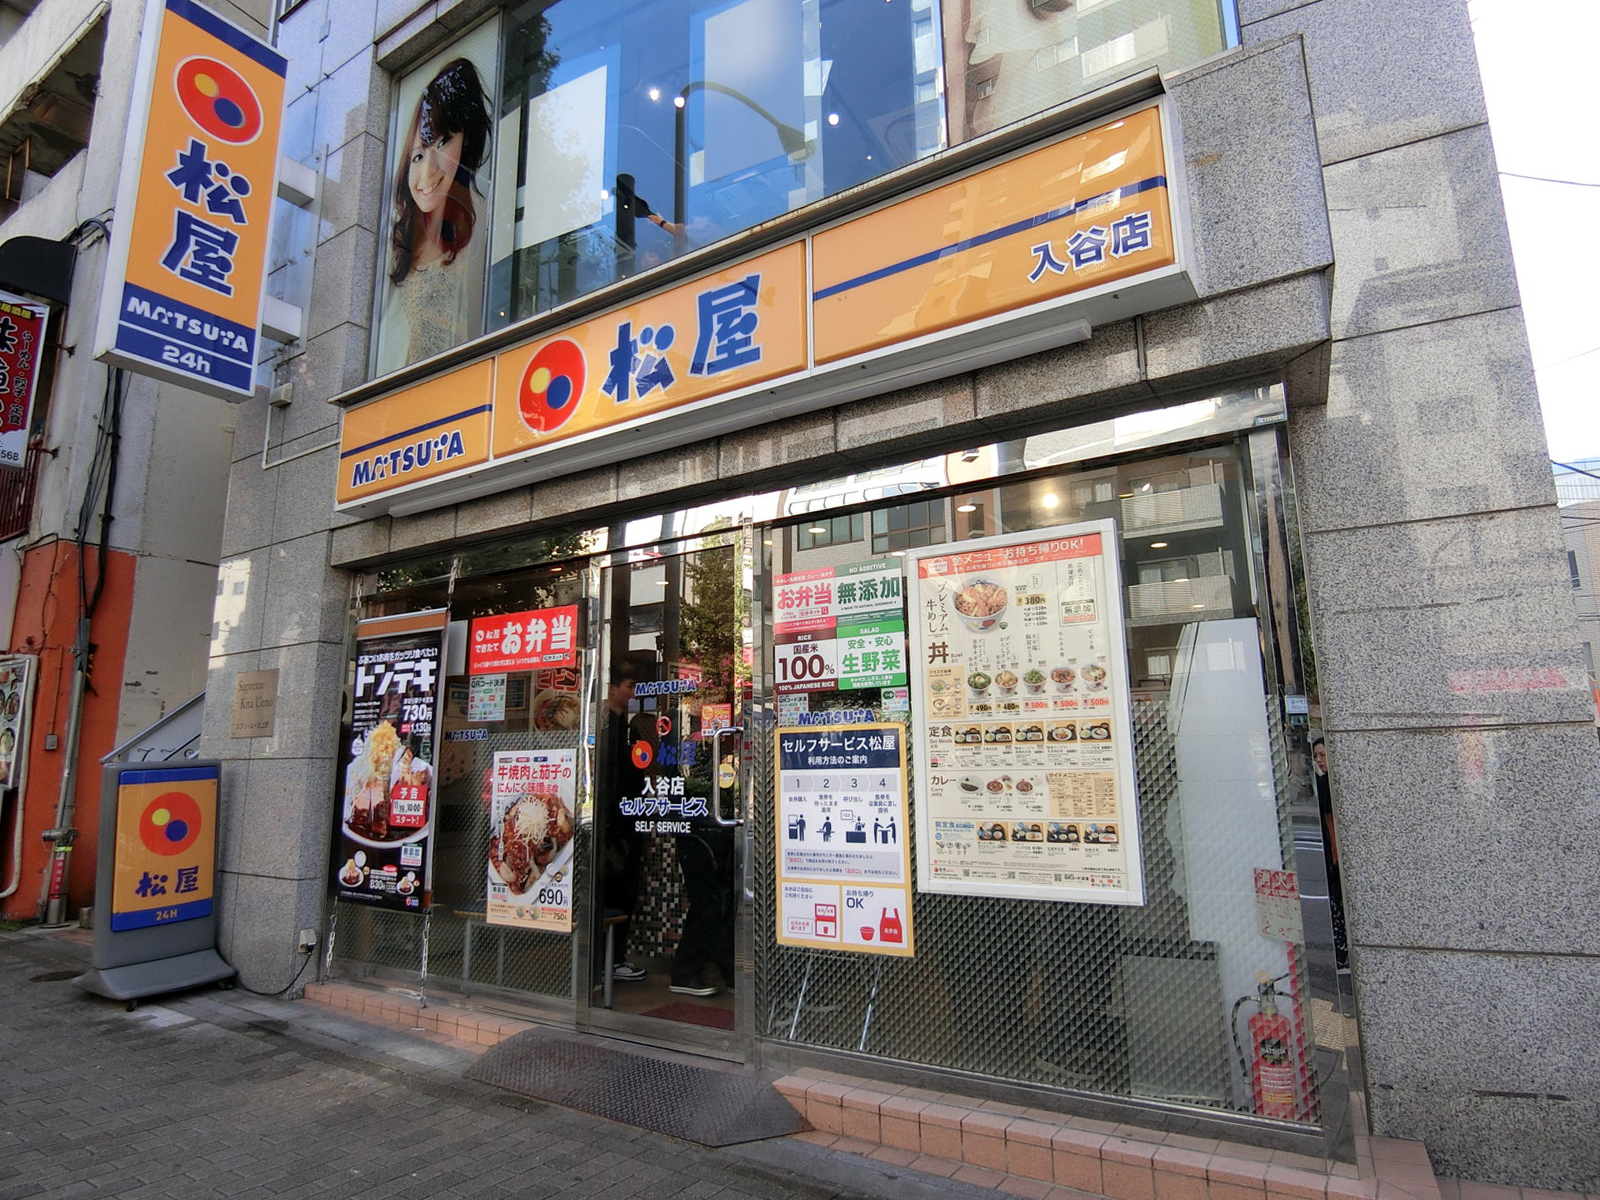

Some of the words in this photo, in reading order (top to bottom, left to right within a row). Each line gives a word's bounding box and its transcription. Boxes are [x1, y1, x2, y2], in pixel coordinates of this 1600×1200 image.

[160, 136, 252, 298] 松屋
[1026, 211, 1153, 284] 入谷店
[126, 296, 249, 354] MATSUYA
[602, 272, 764, 406] 松屋
[161, 344, 212, 374] 24h
[351, 429, 466, 489] MATSUYA
[777, 582, 832, 609] お弁当
[837, 576, 900, 604] 無添加
[1025, 596, 1046, 605] 380円
[926, 599, 937, 633] 牛めし
[502, 614, 572, 655] お弁当
[848, 636, 893, 650] 安全・安心
[475, 643, 500, 653] できたて
[793, 643, 819, 655] 国産米
[928, 641, 949, 664] 丼
[779, 654, 835, 680] 100%
[842, 649, 900, 674] 生野菜
[356, 658, 437, 698] トンテキ
[778, 683, 792, 691] 100%
[793, 682, 821, 690] JAPANESE
[929, 725, 952, 737] 定食
[656, 740, 696, 766] 松屋
[782, 735, 896, 754] セルフサービス松屋
[808, 755, 868, 766] 利用方法のご案内
[497, 764, 572, 781] 牛焼肉と茄子の
[931, 775, 956, 785] カレー
[497, 781, 559, 794] にんにく味噌定食
[641, 775, 685, 796] 入谷店
[796, 779, 800, 788] 1
[823, 778, 830, 788] 2
[851, 778, 858, 788] 3
[879, 777, 886, 788] 4
[400, 787, 418, 799] 予告
[619, 796, 709, 817] セルフサービス
[635, 821, 654, 832] SELF
[656, 821, 691, 834] SERVICE
[135, 865, 200, 898] 松屋
[846, 889, 874, 898] お持ち帰り
[846, 897, 864, 909] OK
[155, 908, 178, 921] 24H
